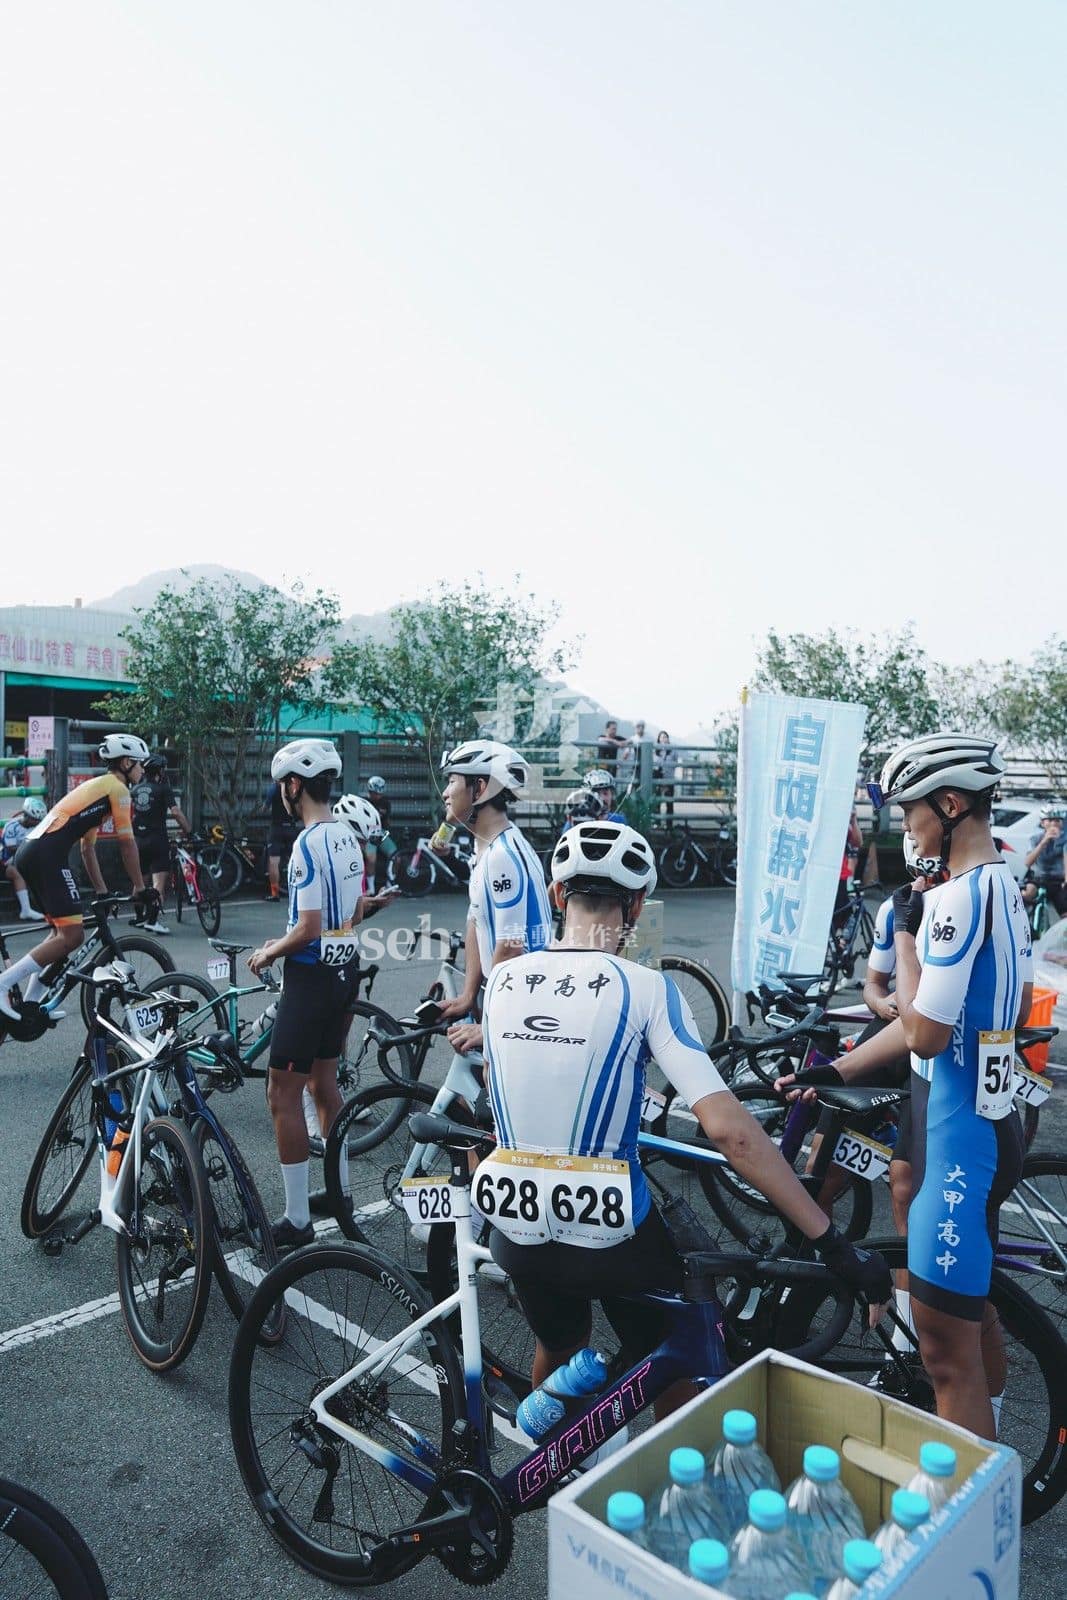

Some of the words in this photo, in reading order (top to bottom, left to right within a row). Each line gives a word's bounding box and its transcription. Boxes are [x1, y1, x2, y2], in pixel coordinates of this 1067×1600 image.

[61, 868, 80, 901] BMC
[214, 963, 229, 978] 177
[323, 943, 355, 965] 629
[498, 973, 612, 998] 大甲高中
[135, 1004, 159, 1028] 629
[501, 1032, 588, 1046] EXUSTAR
[1013, 1071, 1038, 1100] 27
[836, 1138, 873, 1173] 529
[418, 1186, 452, 1220] 628
[476, 1173, 540, 1222] 628
[551, 1183, 625, 1229] 628
[935, 1164, 967, 1277] 大甲高中
[380, 1271, 419, 1318] SWISS
[518, 1362, 652, 1503] GIANT
